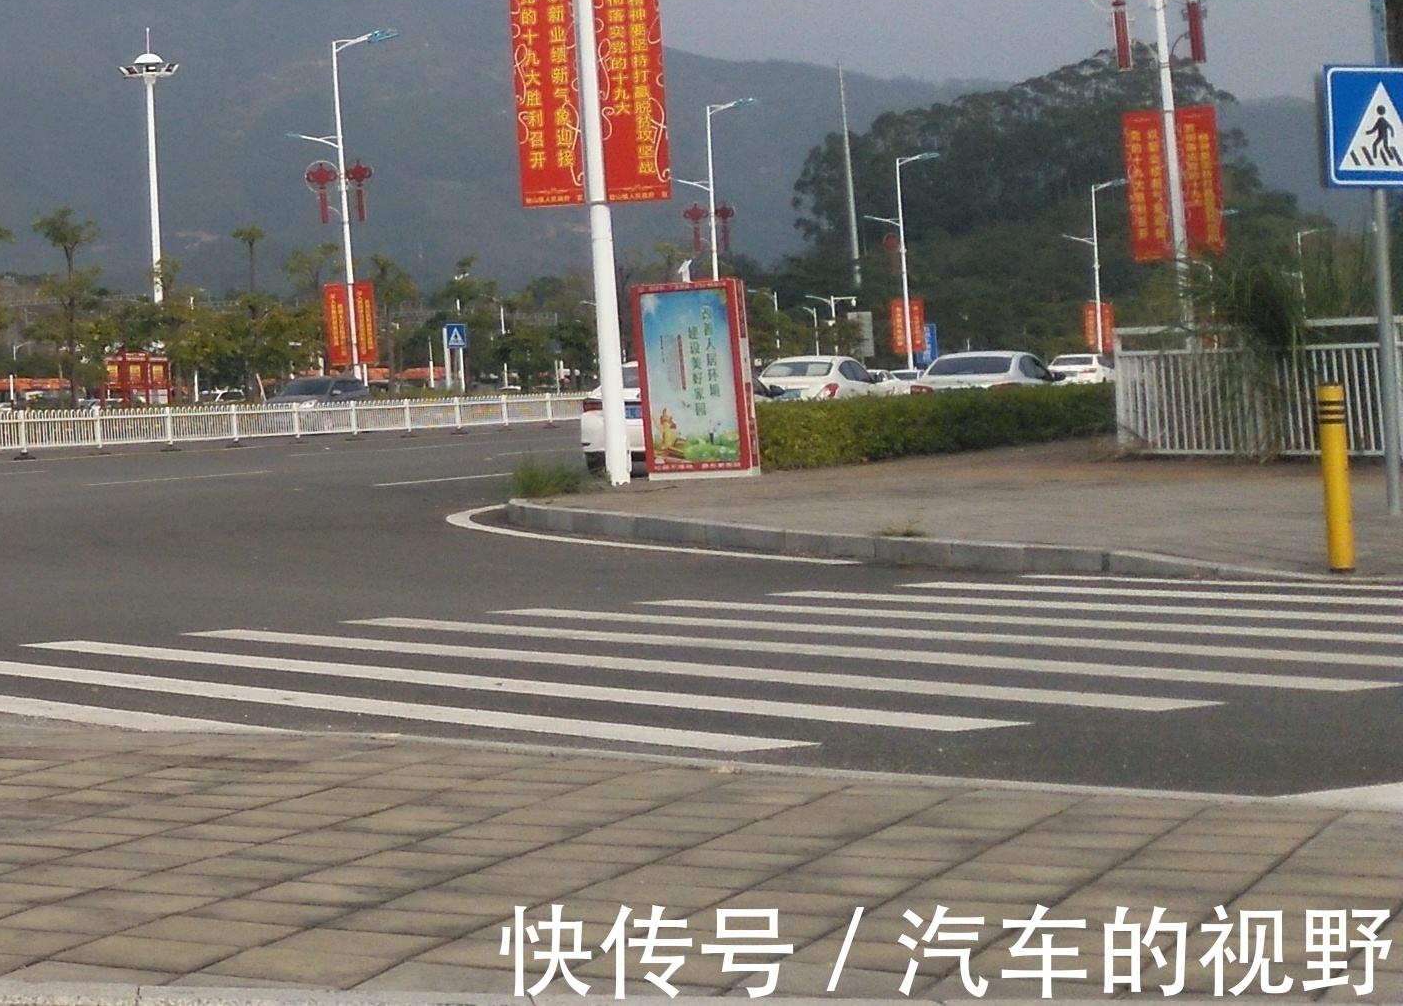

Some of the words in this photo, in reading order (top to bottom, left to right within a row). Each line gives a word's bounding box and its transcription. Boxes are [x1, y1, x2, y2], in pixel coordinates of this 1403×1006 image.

[688, 325, 707, 416] 建设美好家园
